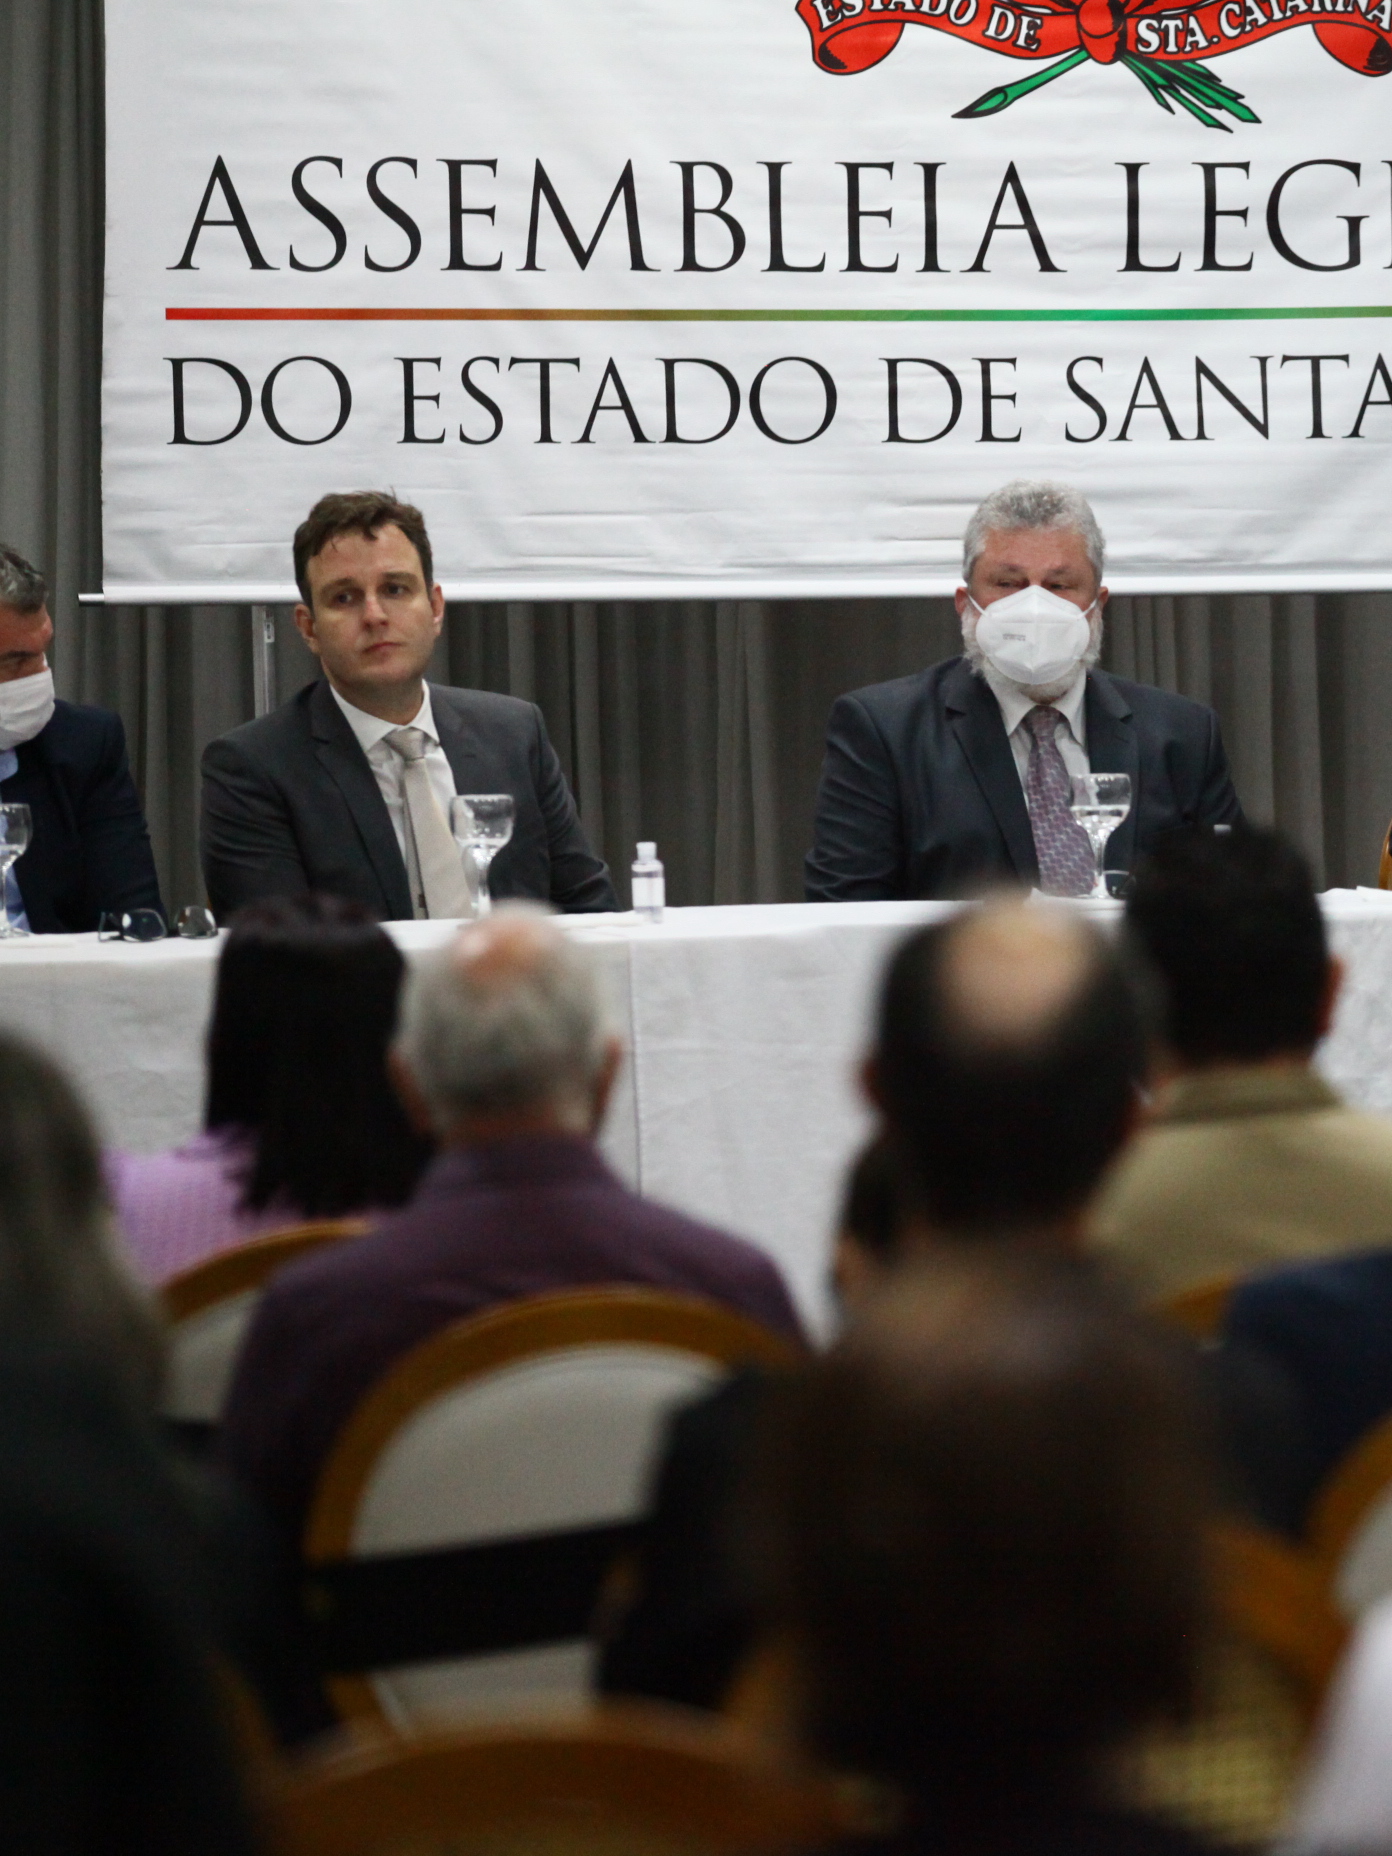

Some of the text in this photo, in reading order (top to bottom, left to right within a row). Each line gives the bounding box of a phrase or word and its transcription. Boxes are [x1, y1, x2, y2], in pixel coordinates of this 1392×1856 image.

[985, 6, 1041, 50] DE
[166, 155, 1066, 273] ASSEMBLEIA
[163, 356, 352, 446] DO
[394, 356, 837, 445] ESTADO
[879, 357, 1022, 444] DE
